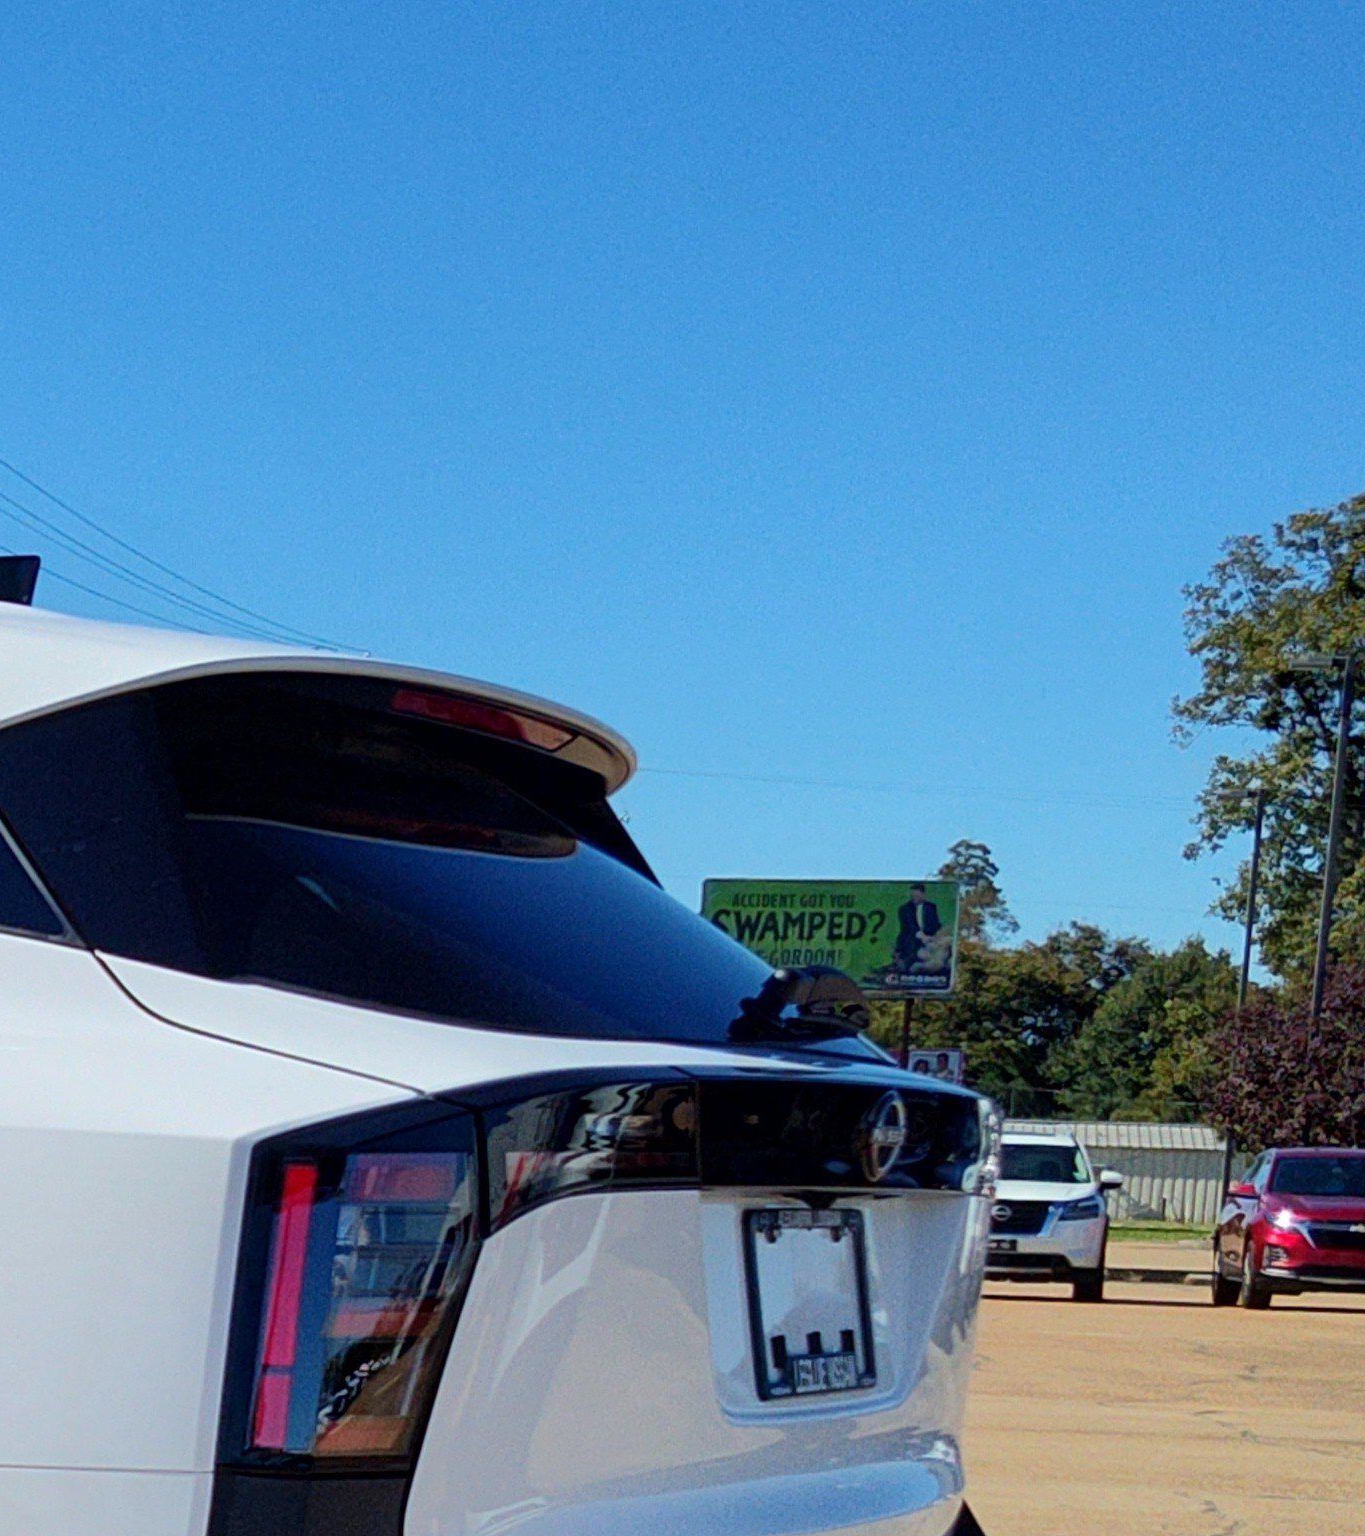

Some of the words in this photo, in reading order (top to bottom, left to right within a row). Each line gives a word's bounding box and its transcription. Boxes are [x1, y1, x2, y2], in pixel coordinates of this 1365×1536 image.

[732, 893, 796, 909] ACCIDENT
[799, 893, 825, 909] GOT
[829, 893, 856, 909] YOU
[710, 908, 886, 944] SWAMPED?
